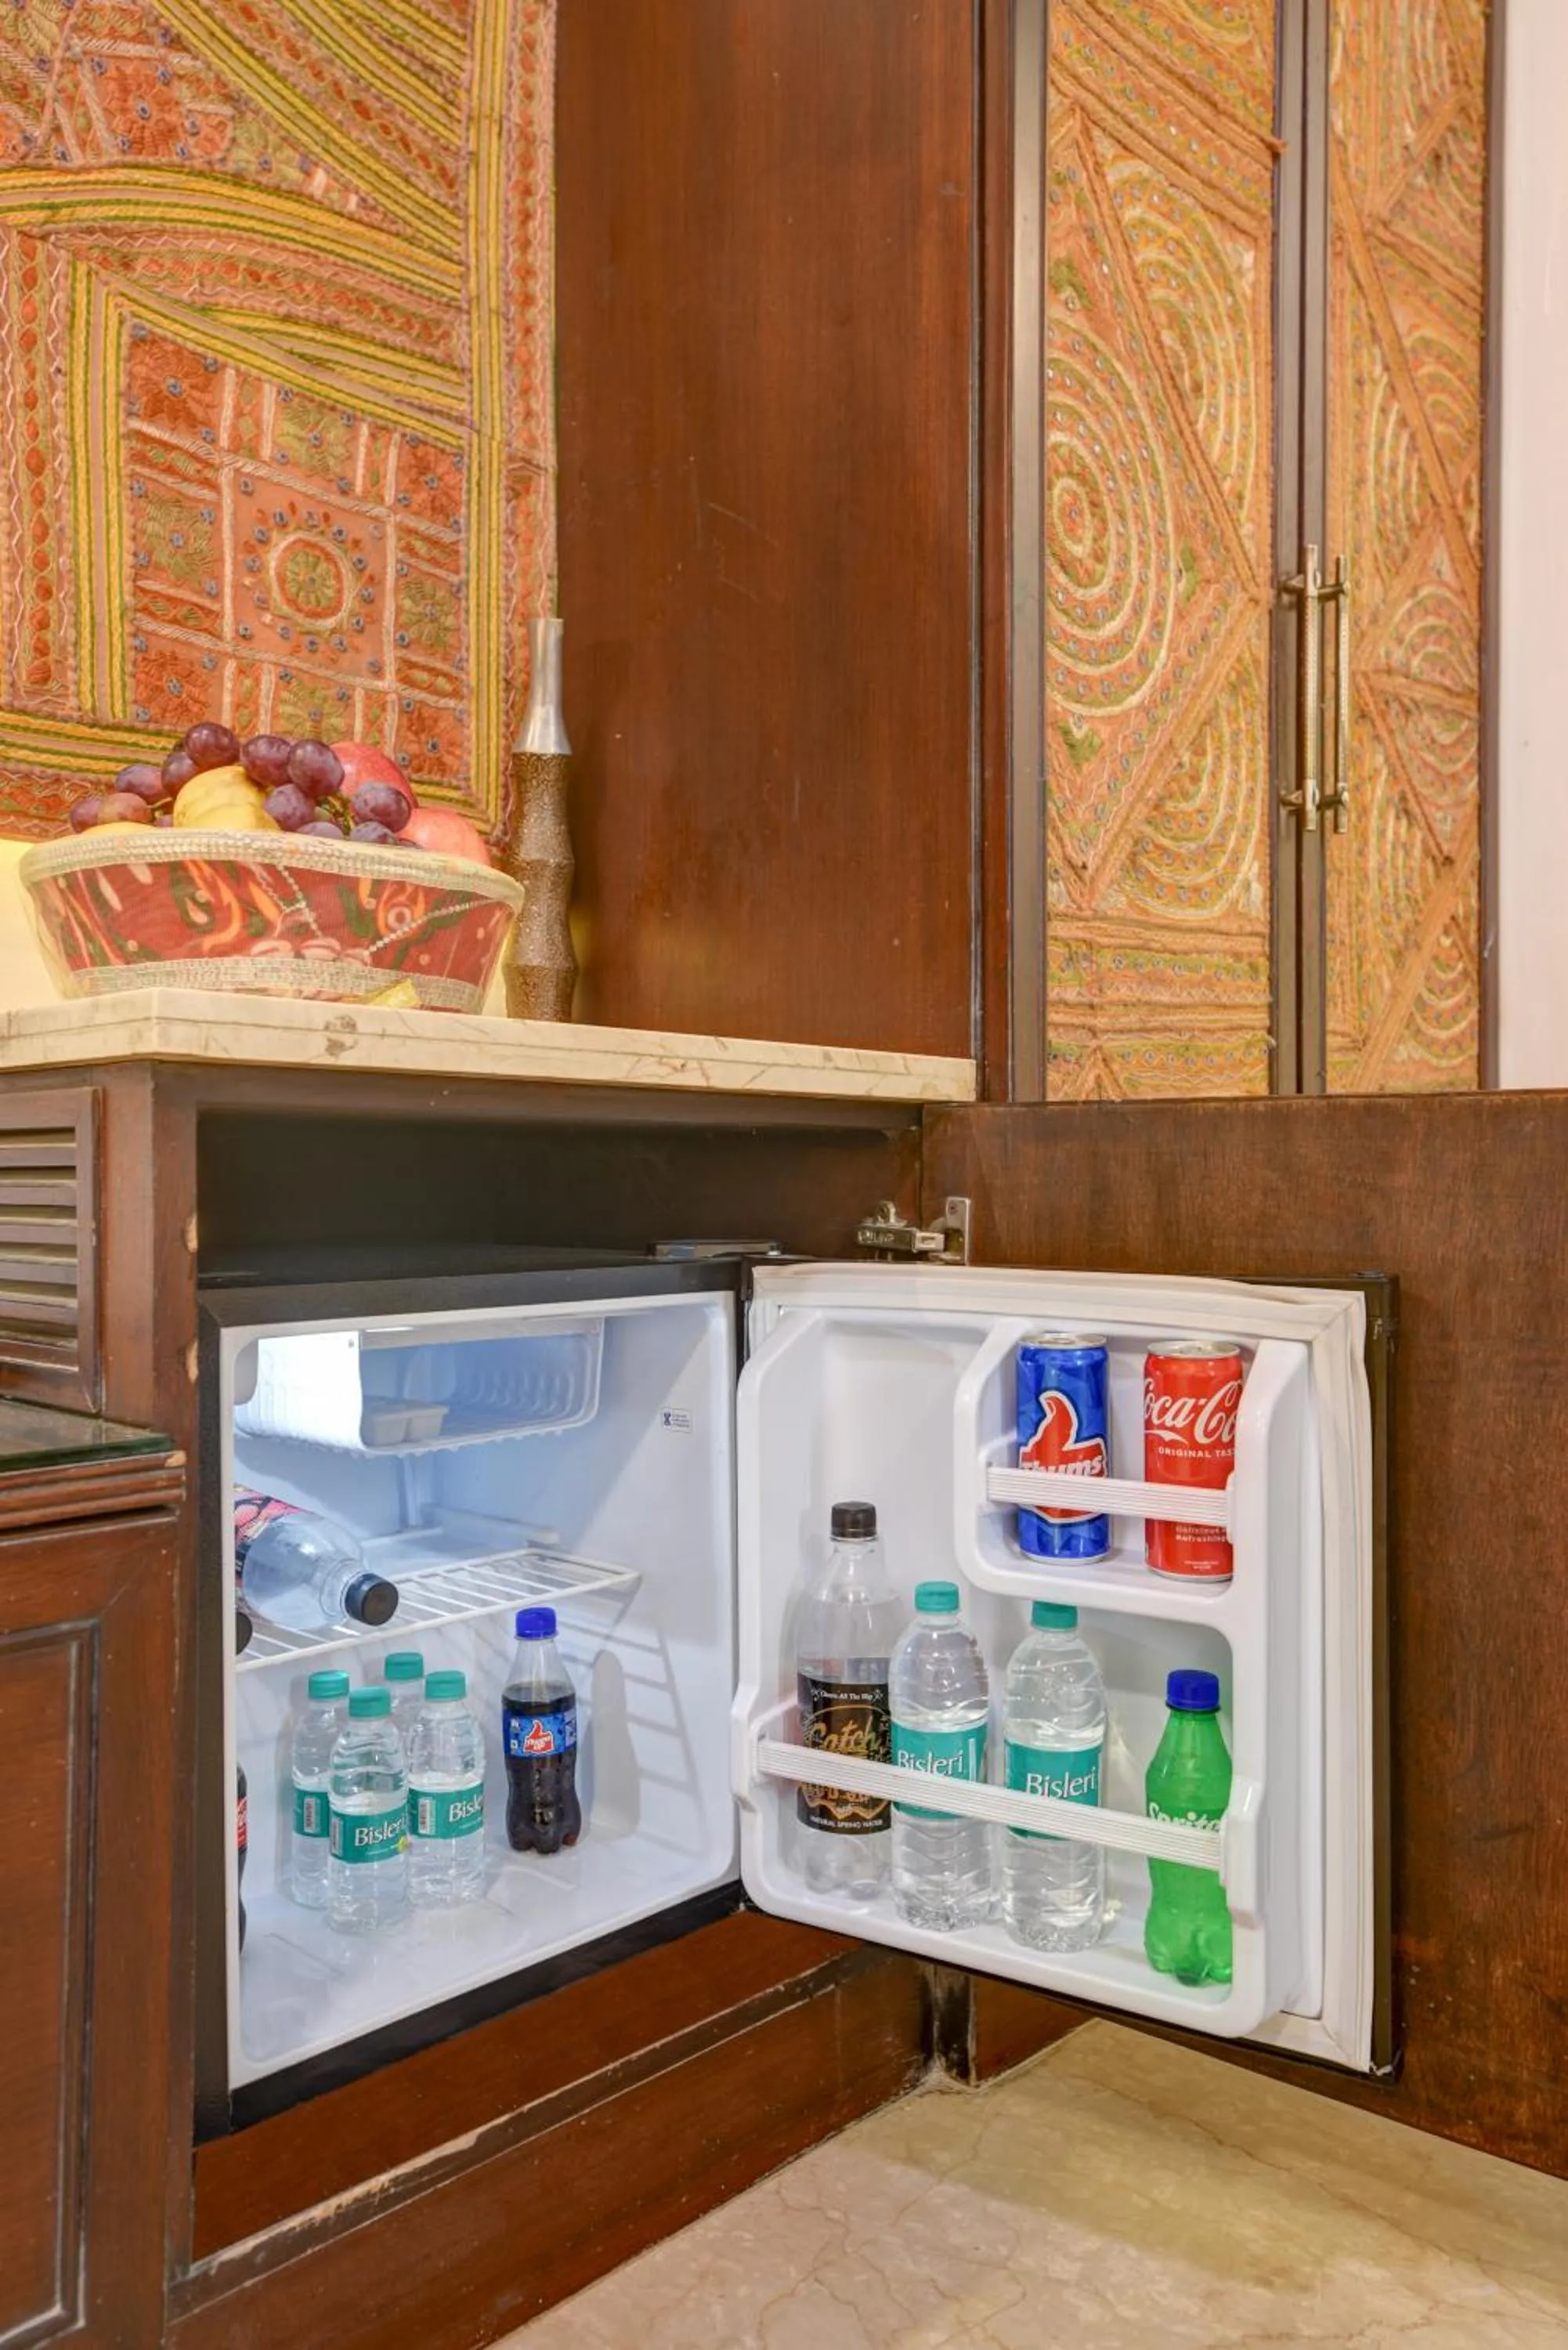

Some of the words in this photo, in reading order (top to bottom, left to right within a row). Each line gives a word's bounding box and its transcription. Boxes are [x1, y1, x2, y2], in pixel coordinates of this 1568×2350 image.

[1159, 1447, 1212, 1458] ORIGINAL
[898, 1749, 963, 1776] Bisleri
[1026, 1765, 1096, 1799] Bisleri
[355, 1813, 408, 1846] Bisleri
